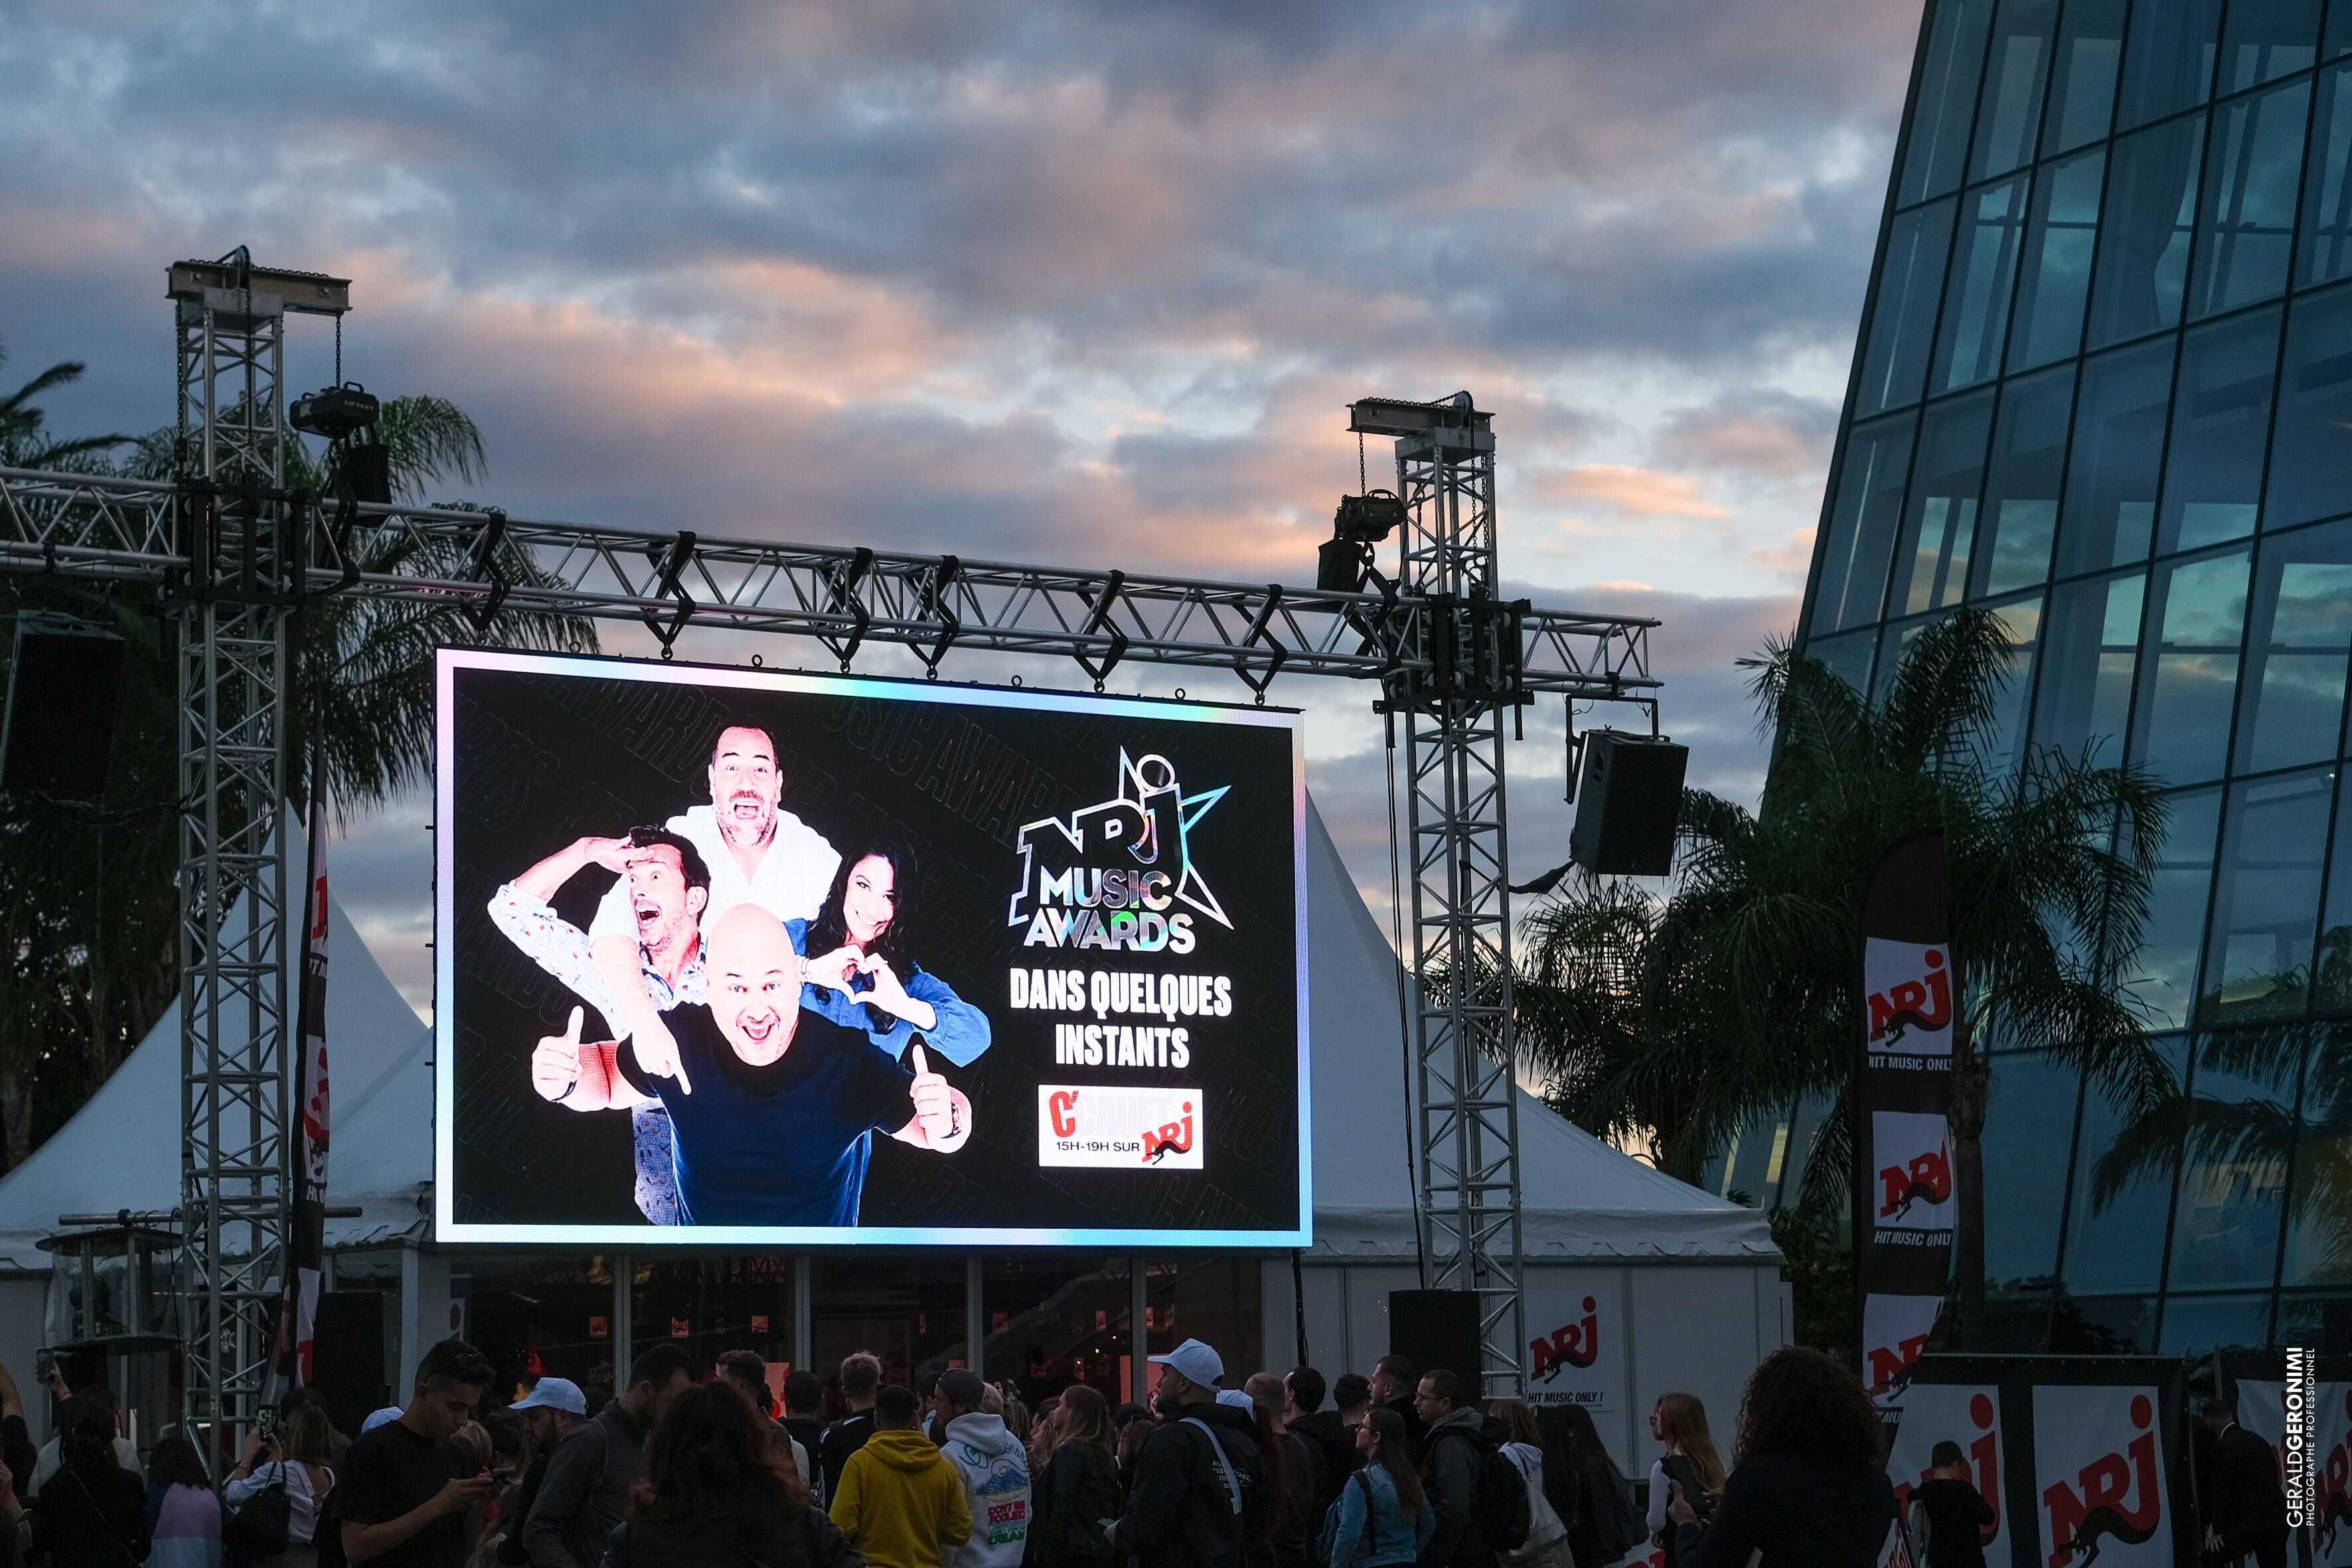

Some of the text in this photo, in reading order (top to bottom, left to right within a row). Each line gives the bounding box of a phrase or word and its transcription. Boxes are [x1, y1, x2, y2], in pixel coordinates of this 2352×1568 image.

[1039, 864, 1173, 911] MUSIC
[1023, 907, 1197, 955] AWARDS
[1009, 967, 1233, 1023] DANS QUELQUES
[1055, 1023, 1190, 1069] INSTANTS
[1869, 1056, 1886, 1068] HIT
[1888, 1056, 1923, 1071] MUSIC
[1056, 1140, 1140, 1152] 15H-19H SUR
[1873, 1229, 1893, 1245] HIT
[1926, 1231, 1952, 1247] ONLY
[1528, 1392, 1543, 1403] HIT
[1544, 1392, 1573, 1403] MUSIC
[1575, 1391, 1598, 1403] ONLY
